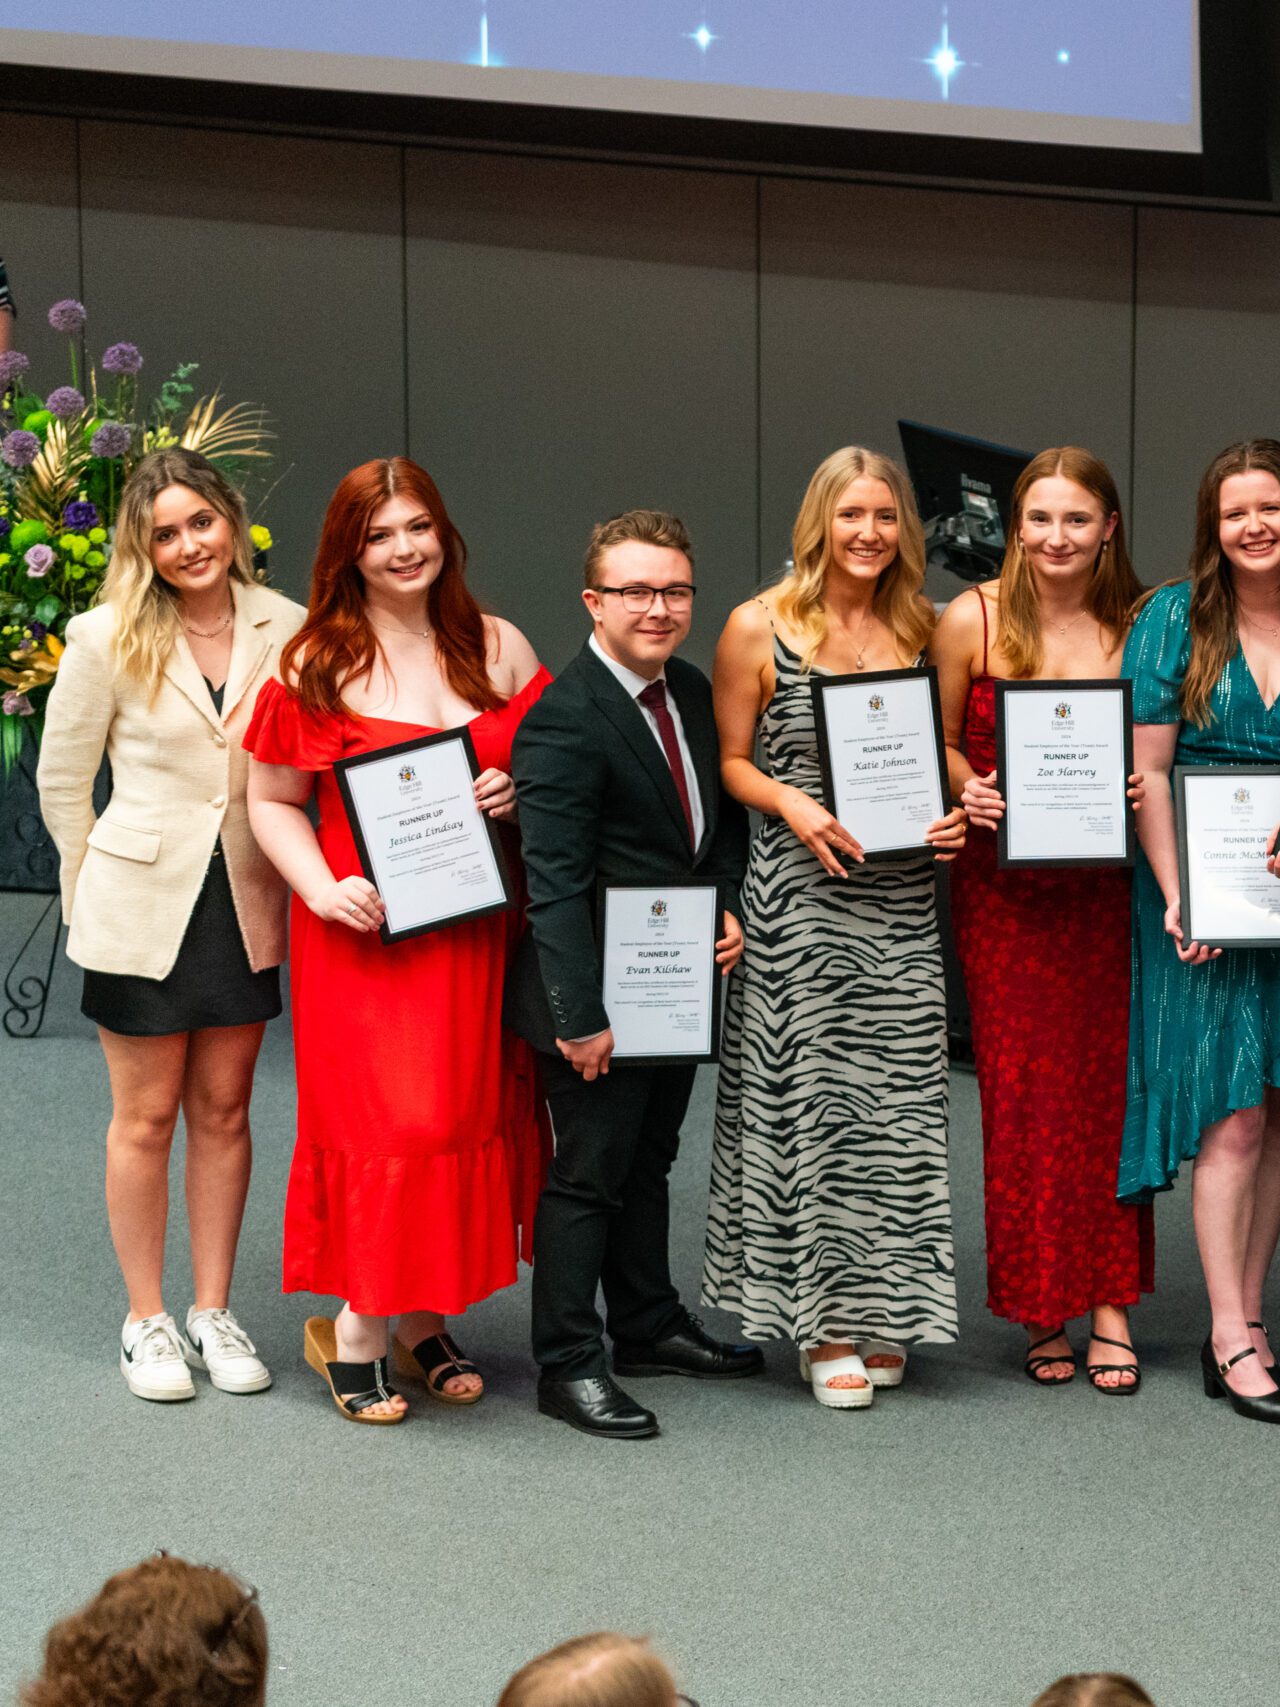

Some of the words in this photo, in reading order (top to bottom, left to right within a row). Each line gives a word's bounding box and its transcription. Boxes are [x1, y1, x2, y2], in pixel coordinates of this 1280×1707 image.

[863, 745, 892, 753] RUNNER
[853, 761, 879, 771] Katie
[881, 757, 917, 769] Johnson
[1037, 768, 1054, 776] Zoe
[1057, 767, 1096, 779] Harvey
[399, 813, 431, 826] RUNNER
[433, 809, 443, 817] UP
[389, 833, 422, 848] Jessica
[425, 821, 463, 837] Lindsay
[1204, 851, 1237, 859] Connie
[626, 966, 650, 974] Evan
[653, 964, 691, 974] Kilshaw
